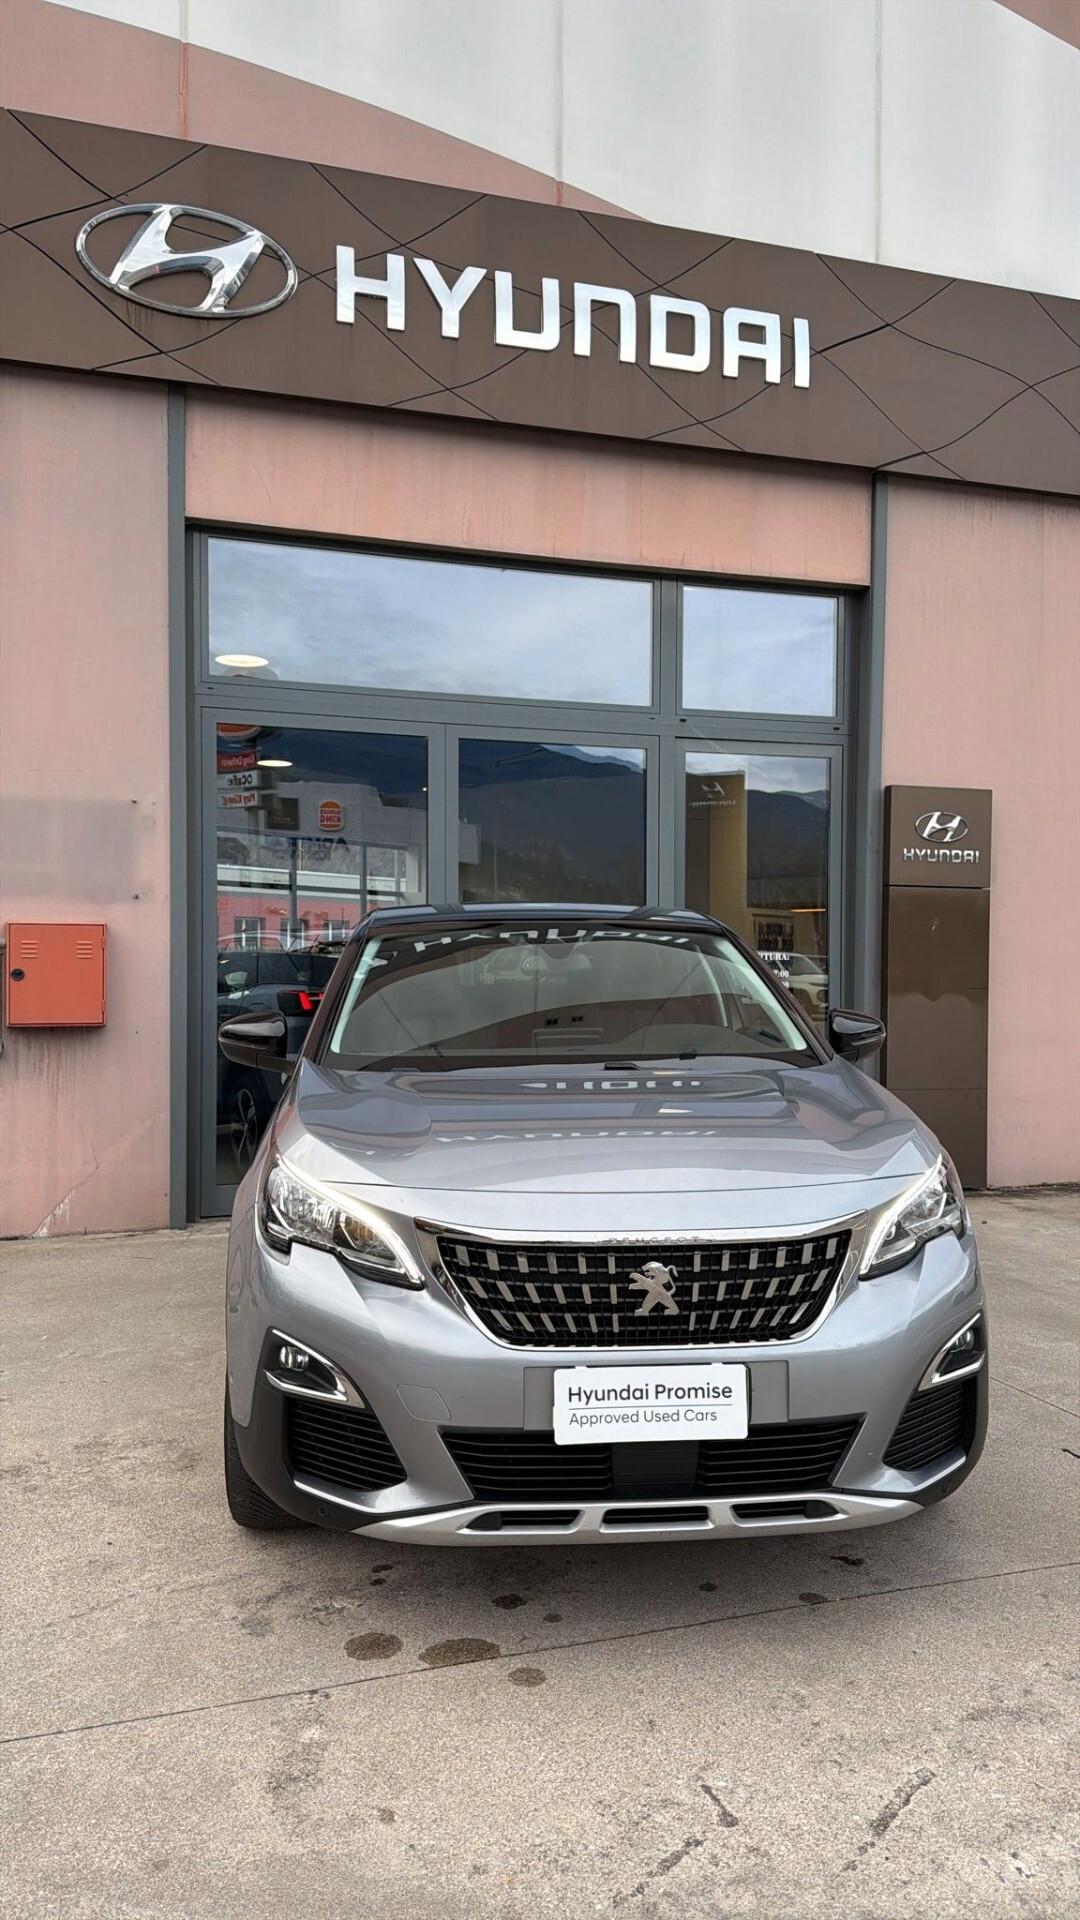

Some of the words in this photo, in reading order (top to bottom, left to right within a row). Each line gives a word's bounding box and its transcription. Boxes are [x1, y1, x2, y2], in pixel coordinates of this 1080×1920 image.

[336, 244, 811, 389] HYUNDAI
[903, 848, 980, 863] HYUNDAI
[568, 1384, 649, 1405] Hyundai
[655, 1382, 733, 1400] Promise
[569, 1410, 640, 1427] Approved
[644, 1410, 680, 1423] Used
[683, 1409, 718, 1422] Cars
